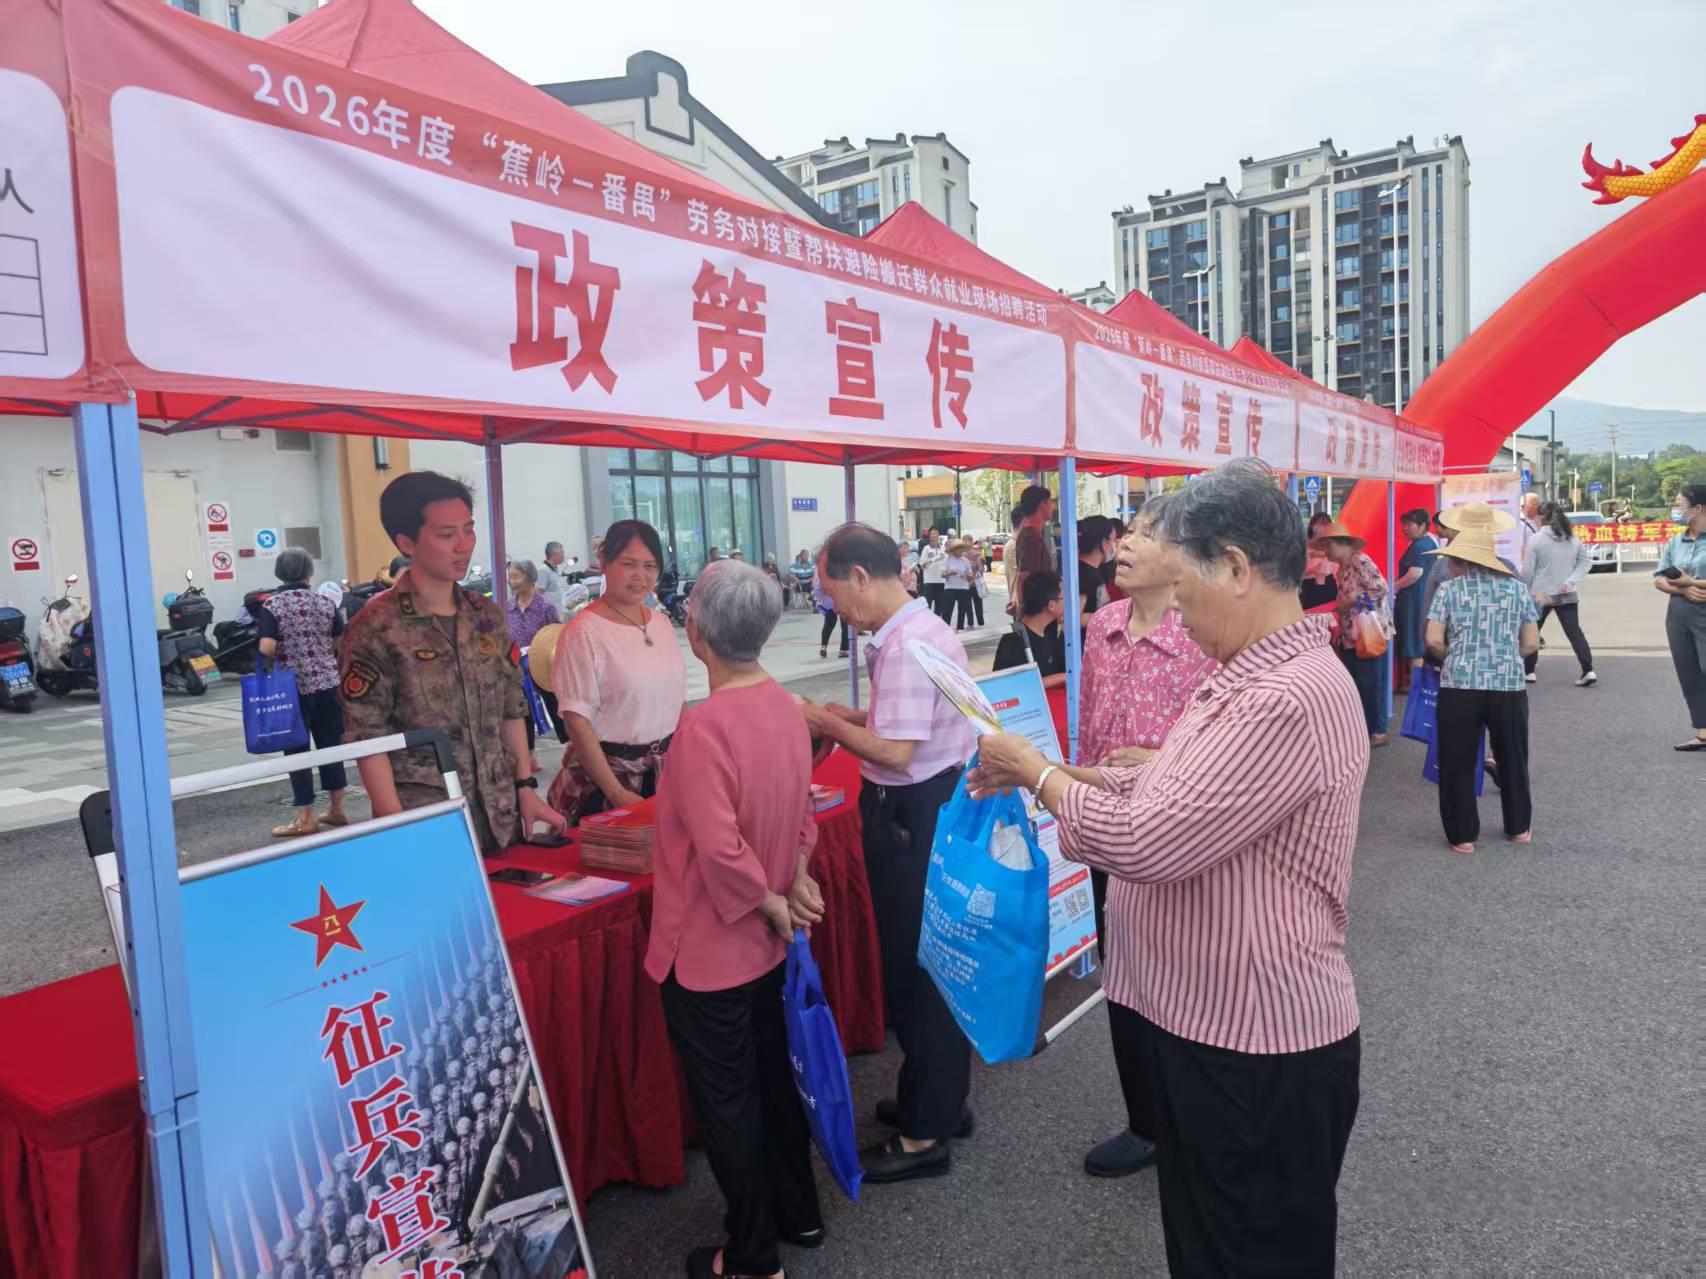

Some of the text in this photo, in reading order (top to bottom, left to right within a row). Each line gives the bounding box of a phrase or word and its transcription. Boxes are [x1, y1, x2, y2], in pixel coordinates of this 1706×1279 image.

[510, 221, 975, 430] 政策宣传
[1139, 373, 1264, 457] 政策宣传
[320, 991, 463, 1279] 征兵宣
